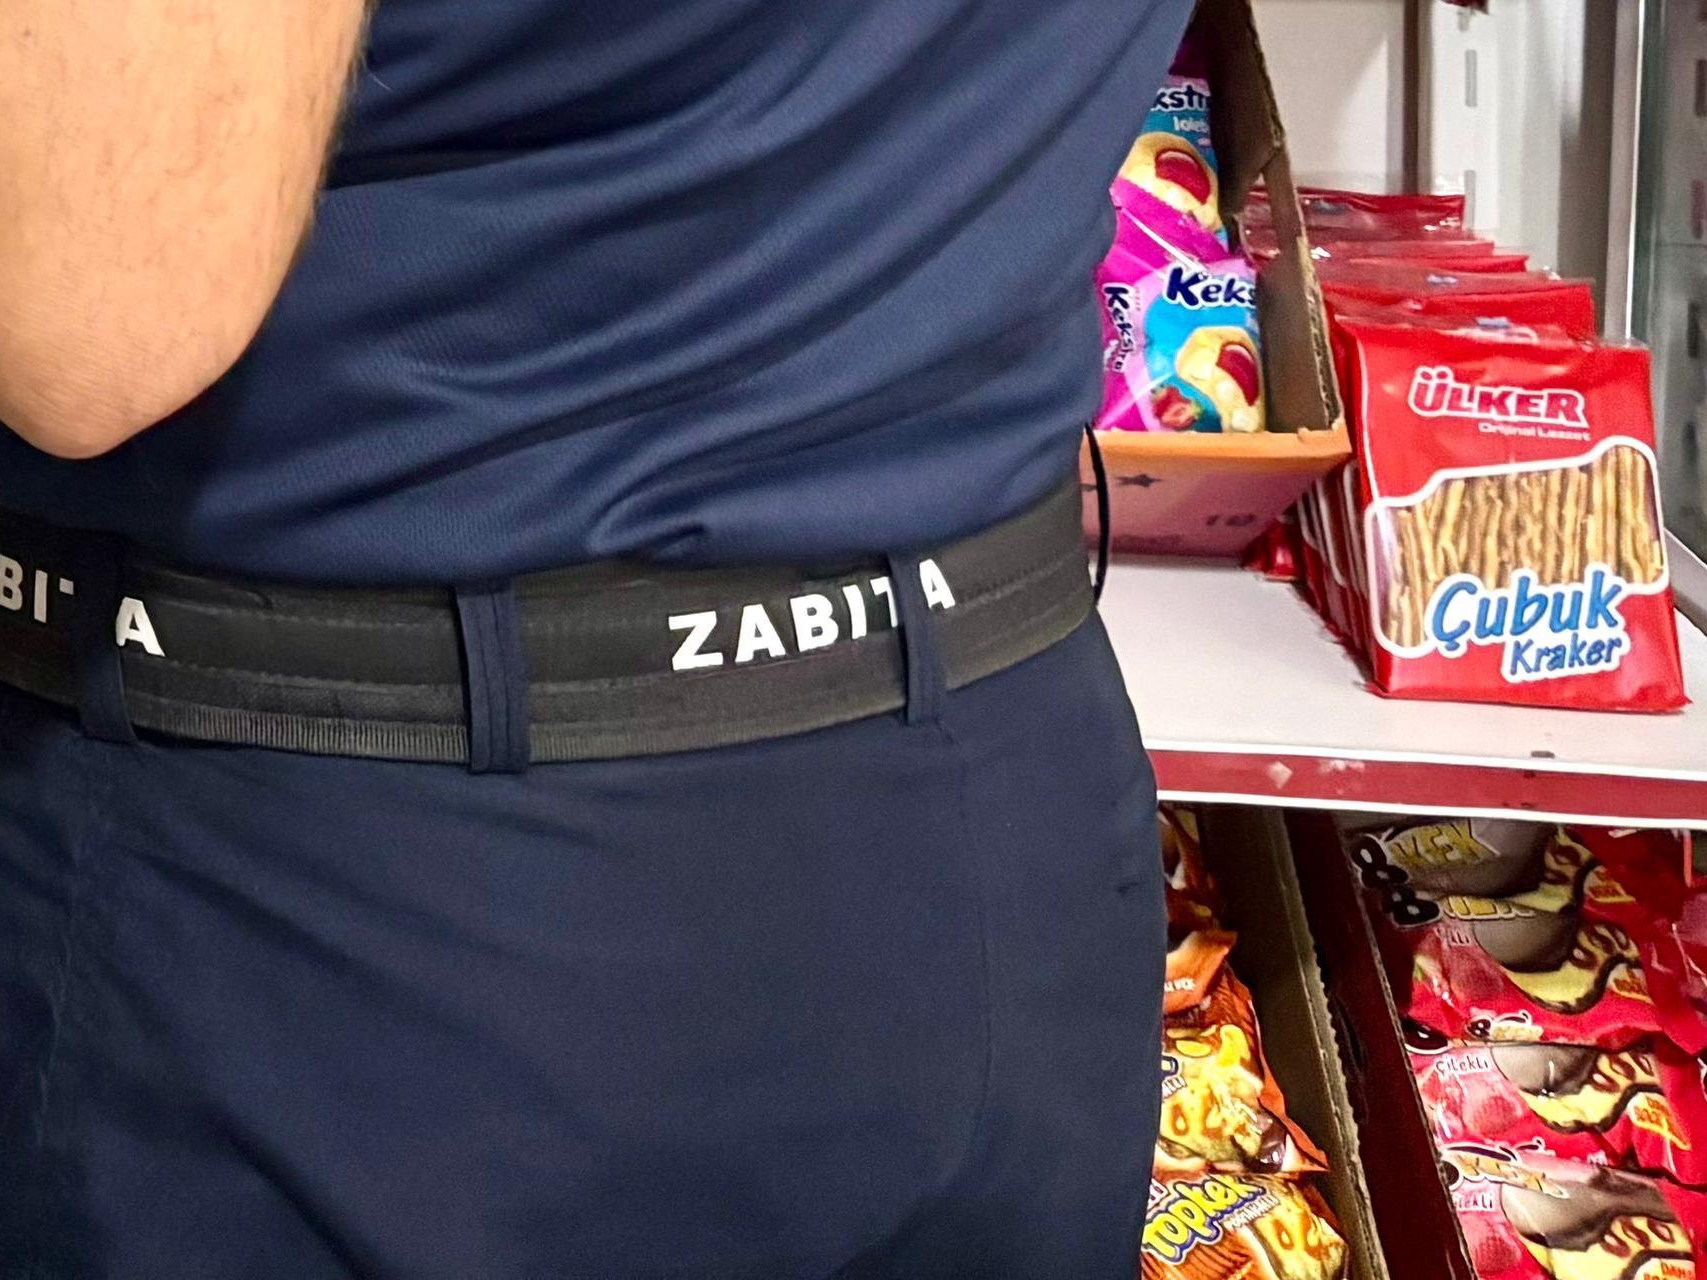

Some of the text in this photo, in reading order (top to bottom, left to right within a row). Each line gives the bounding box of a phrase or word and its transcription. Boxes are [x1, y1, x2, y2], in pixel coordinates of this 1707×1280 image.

[1163, 266, 1258, 309] Keks
[1407, 365, 1589, 428] ÜLKER
[1431, 562, 1629, 658] Çubuk
[1503, 631, 1626, 682] Kraker
[1452, 1190, 1496, 1212] ilekli
